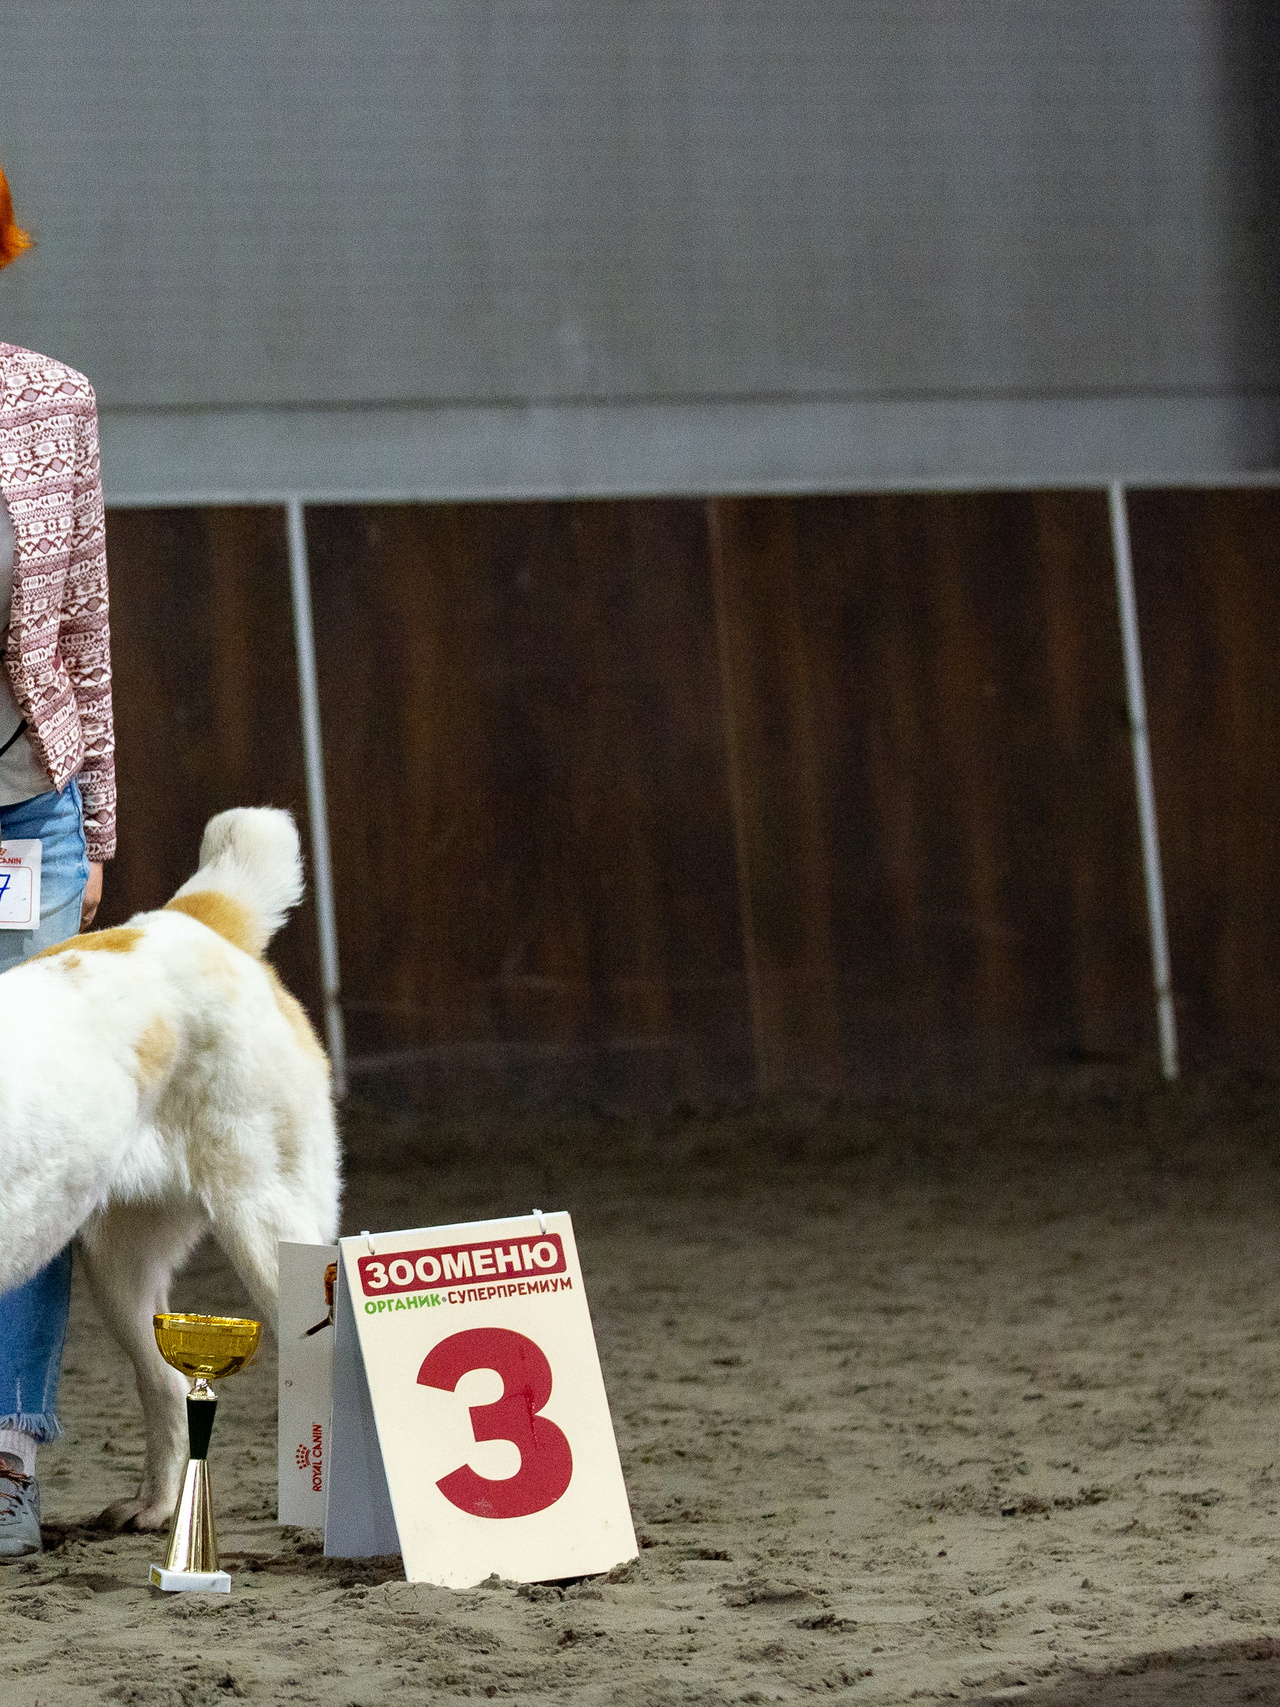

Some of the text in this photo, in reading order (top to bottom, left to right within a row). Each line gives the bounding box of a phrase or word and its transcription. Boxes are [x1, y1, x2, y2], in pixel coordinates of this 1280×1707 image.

[365, 1241, 558, 1289] ЗООМЕНЮ
[416, 1327, 573, 1519] 3
[312, 1424, 322, 1492] ROYAL CANIN
